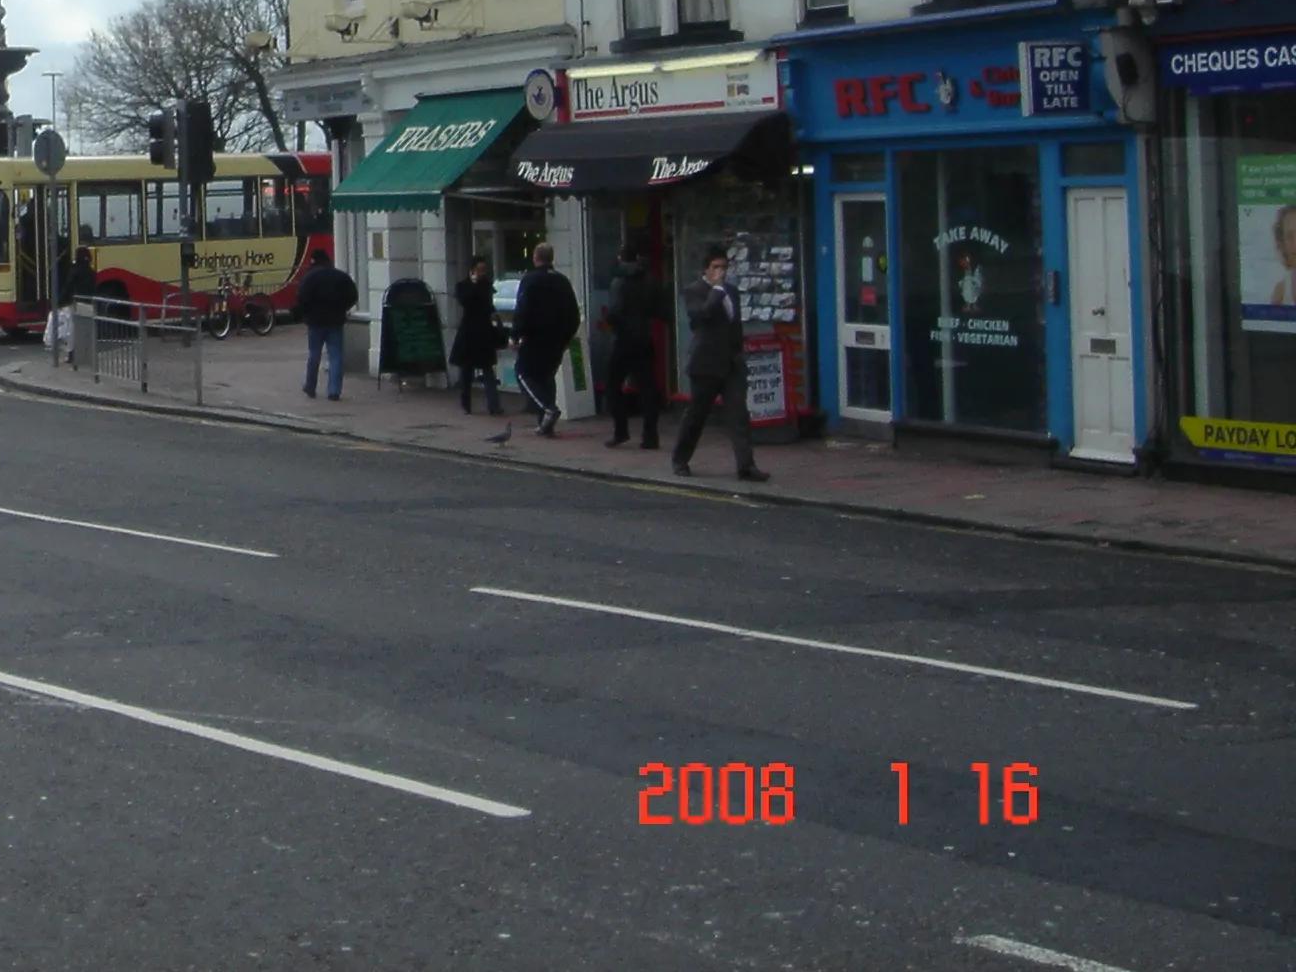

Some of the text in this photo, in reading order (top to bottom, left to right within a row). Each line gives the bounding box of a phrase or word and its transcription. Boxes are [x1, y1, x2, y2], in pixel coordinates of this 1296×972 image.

[1034, 46, 1083, 68] RFC
[1171, 47, 1260, 75] CHEQUES
[1039, 70, 1079, 82] OPEN
[573, 76, 659, 113] The Argus
[833, 72, 931, 118] RFC
[1045, 84, 1074, 95] TILL
[1043, 96, 1079, 109] LATE
[385, 119, 498, 154] FRASERS
[517, 161, 575, 188] The Argus
[651, 157, 676, 180] The
[933, 226, 1009, 254] TAKE AWAY
[193, 250, 274, 269] Brighton Hove
[967, 318, 1009, 331] CHICKEN
[957, 332, 1018, 346] VEGETARIAN
[1204, 424, 1270, 447] PAYDAY
